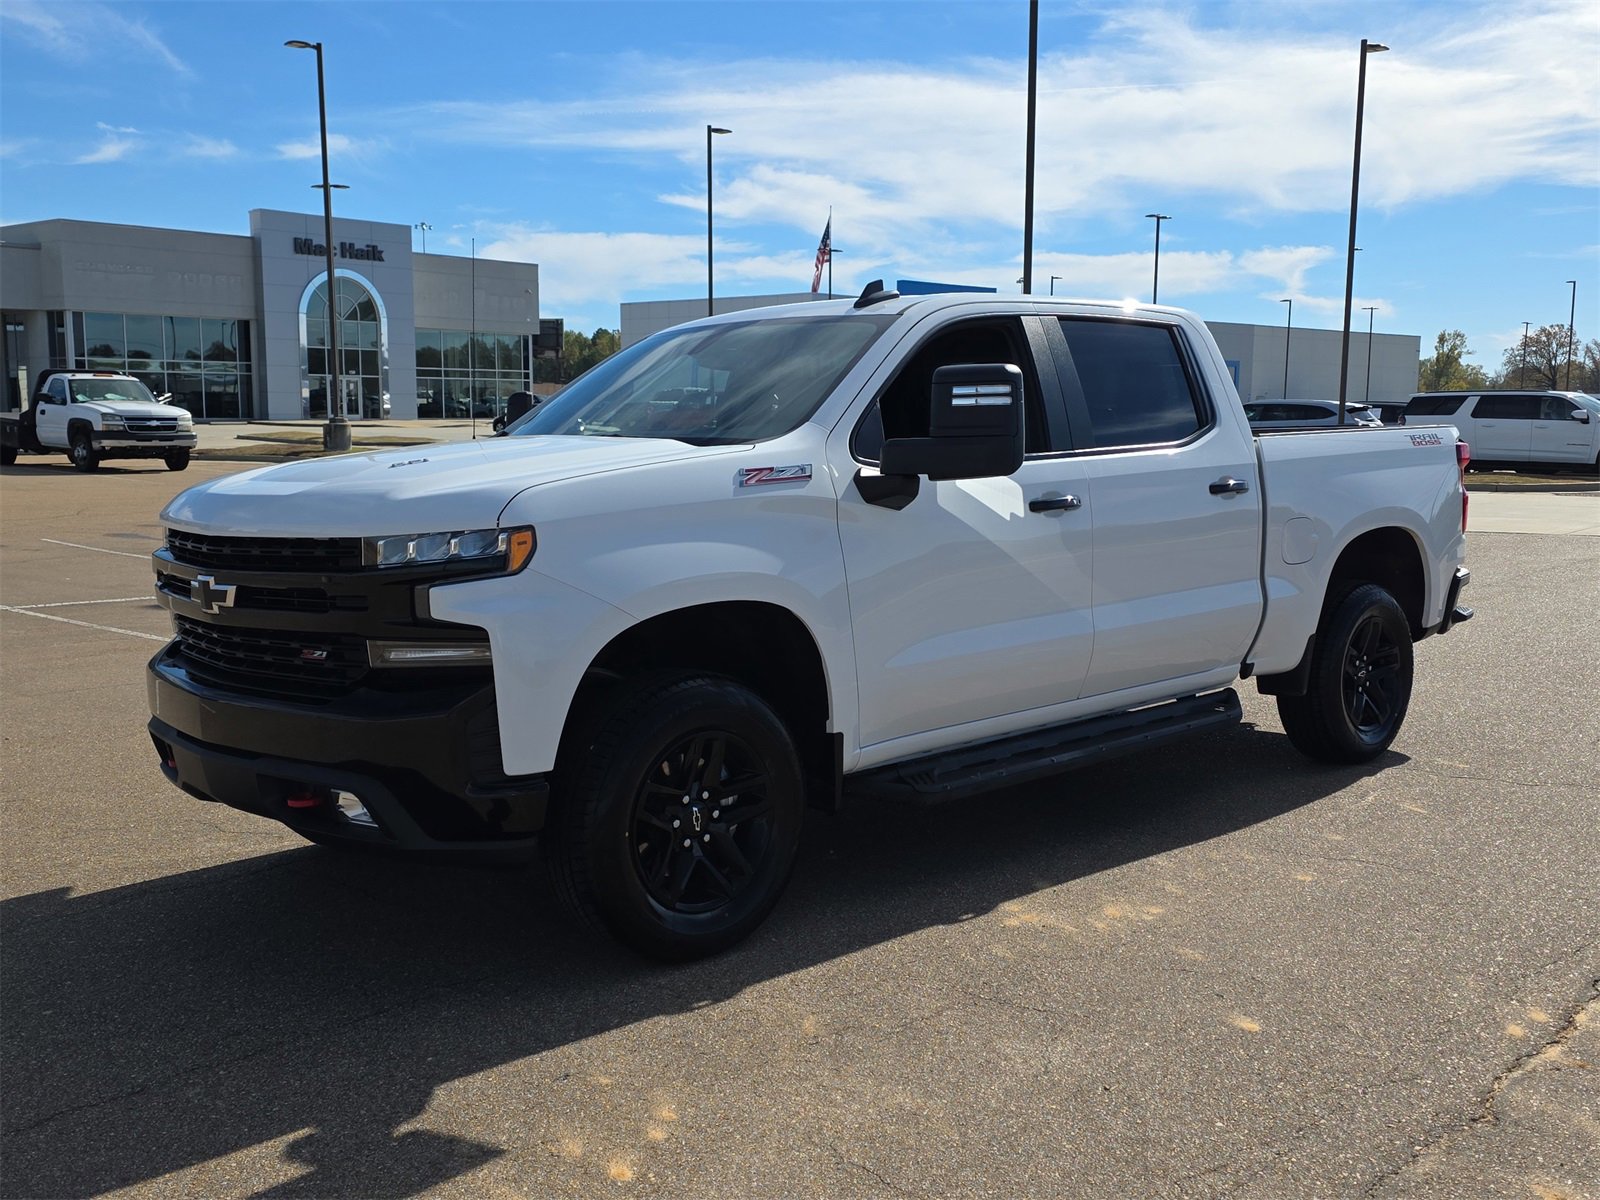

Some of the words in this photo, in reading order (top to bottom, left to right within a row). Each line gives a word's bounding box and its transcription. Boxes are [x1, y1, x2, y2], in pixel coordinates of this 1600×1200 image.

[340, 241, 385, 262] Haik
[1404, 432, 1444, 441] TRAIL
[1412, 439, 1442, 447] BOSS
[739, 464, 812, 487] Z71
